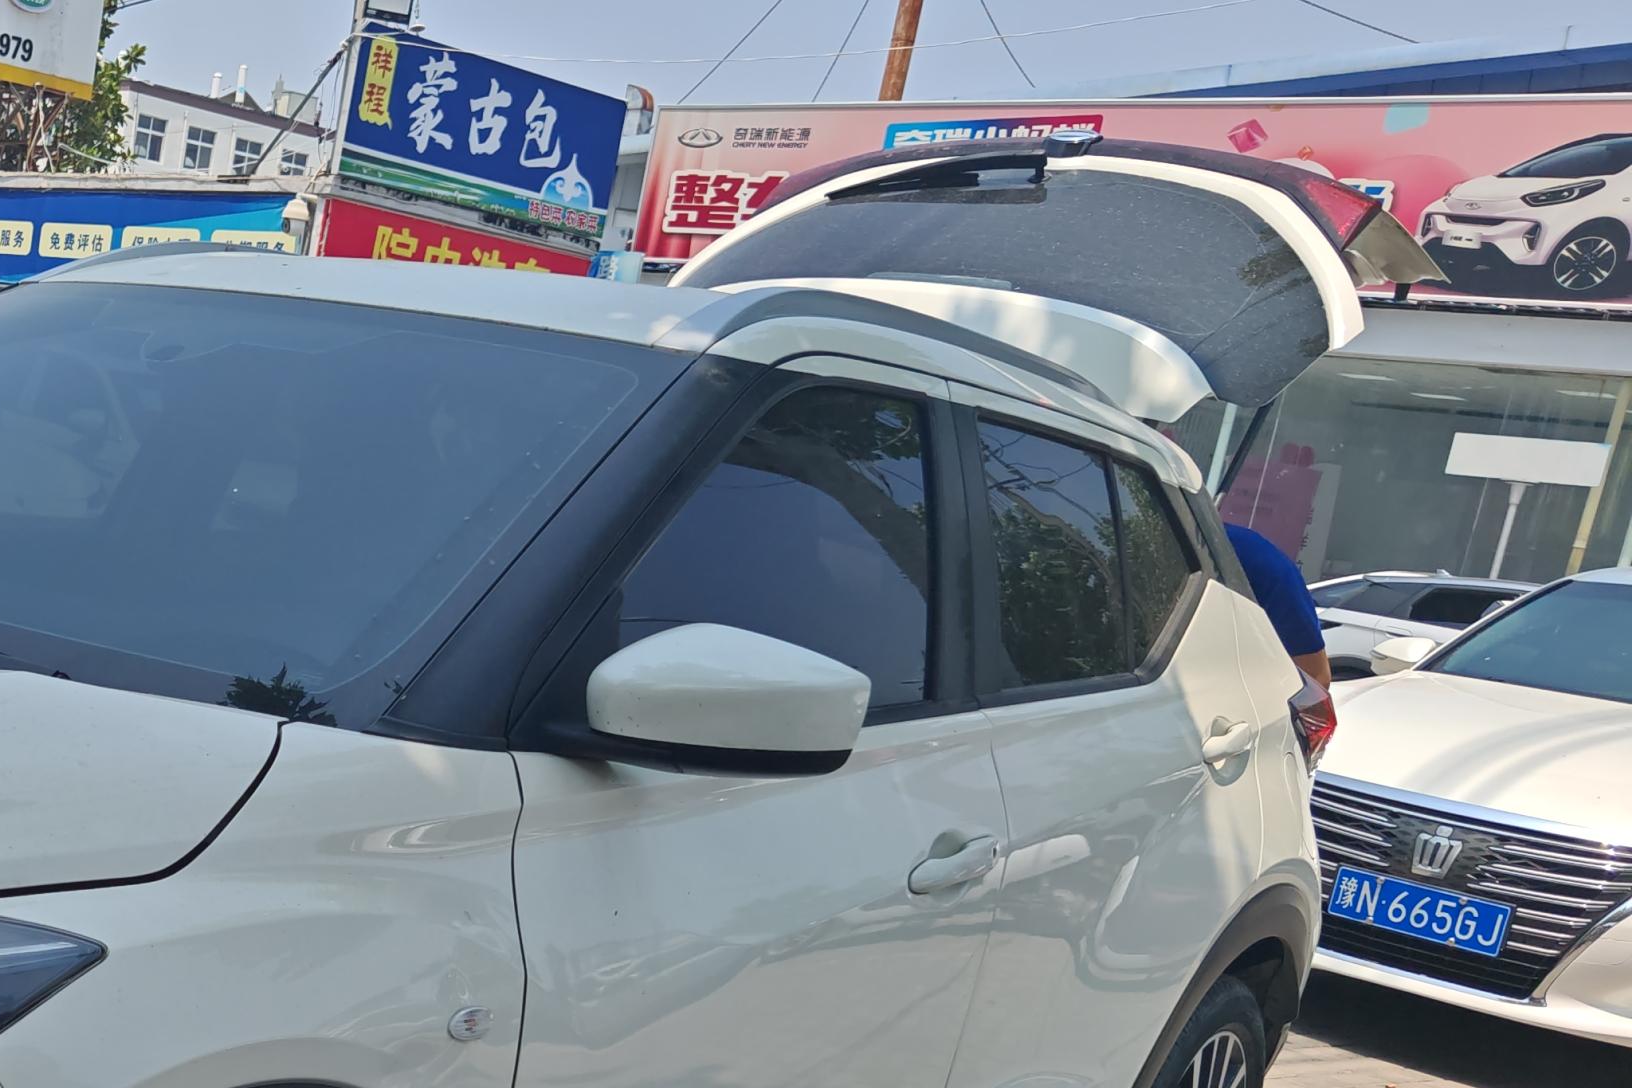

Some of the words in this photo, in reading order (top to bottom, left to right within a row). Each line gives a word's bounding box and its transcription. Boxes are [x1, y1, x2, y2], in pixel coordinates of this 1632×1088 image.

[406, 51, 562, 169] 蒙古包
[733, 127, 812, 141] 奇瑞新能源
[757, 141, 776, 149] NEW
[49, 232, 104, 253] 免费评估
